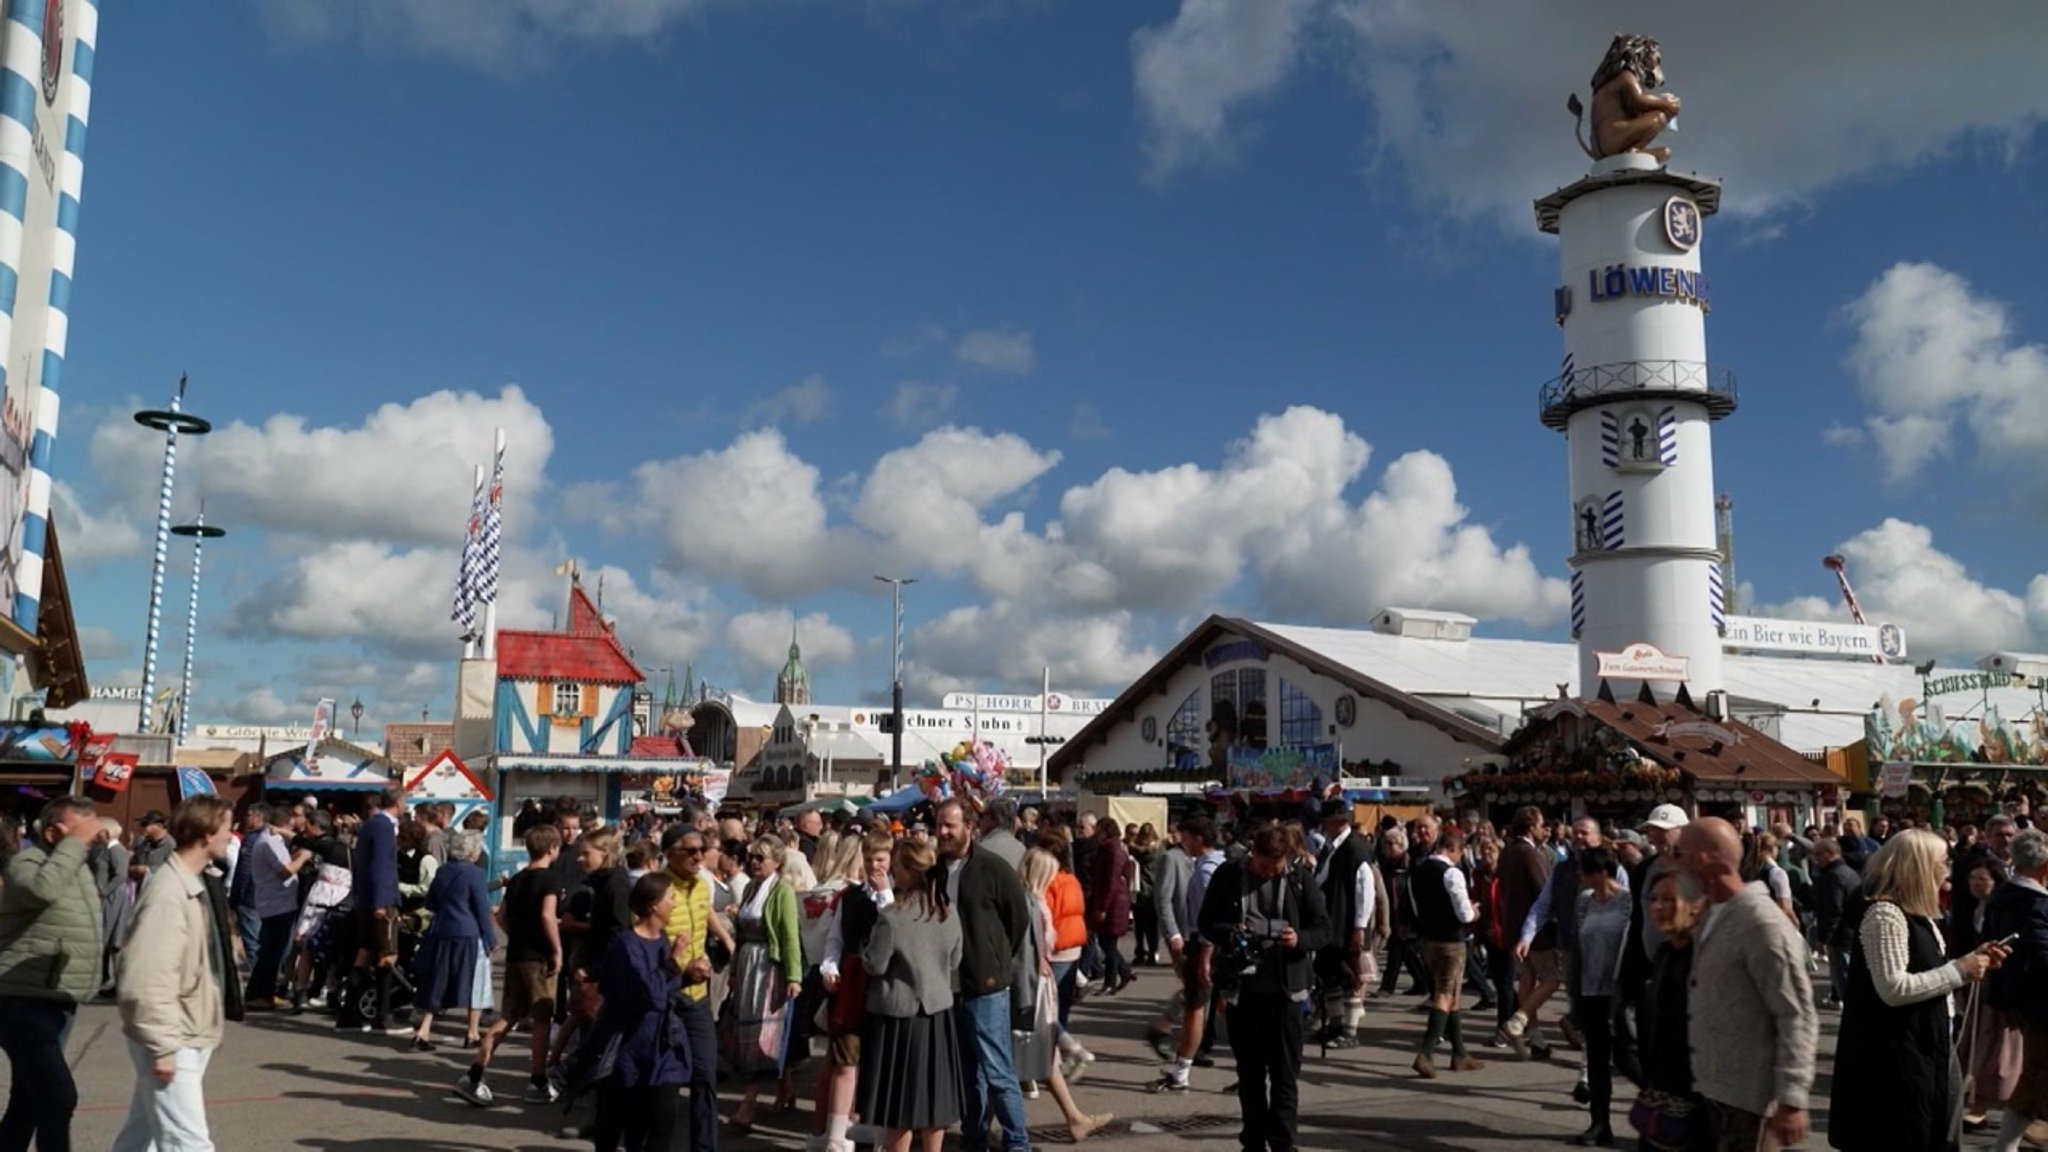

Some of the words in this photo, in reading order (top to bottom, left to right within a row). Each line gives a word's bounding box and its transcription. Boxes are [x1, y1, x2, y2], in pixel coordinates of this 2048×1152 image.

[1753, 623, 1784, 643] Bier
[1792, 626, 1812, 646] wie
[1818, 627, 1872, 653] Bayern.
[955, 695, 1032, 709] PSHORR
